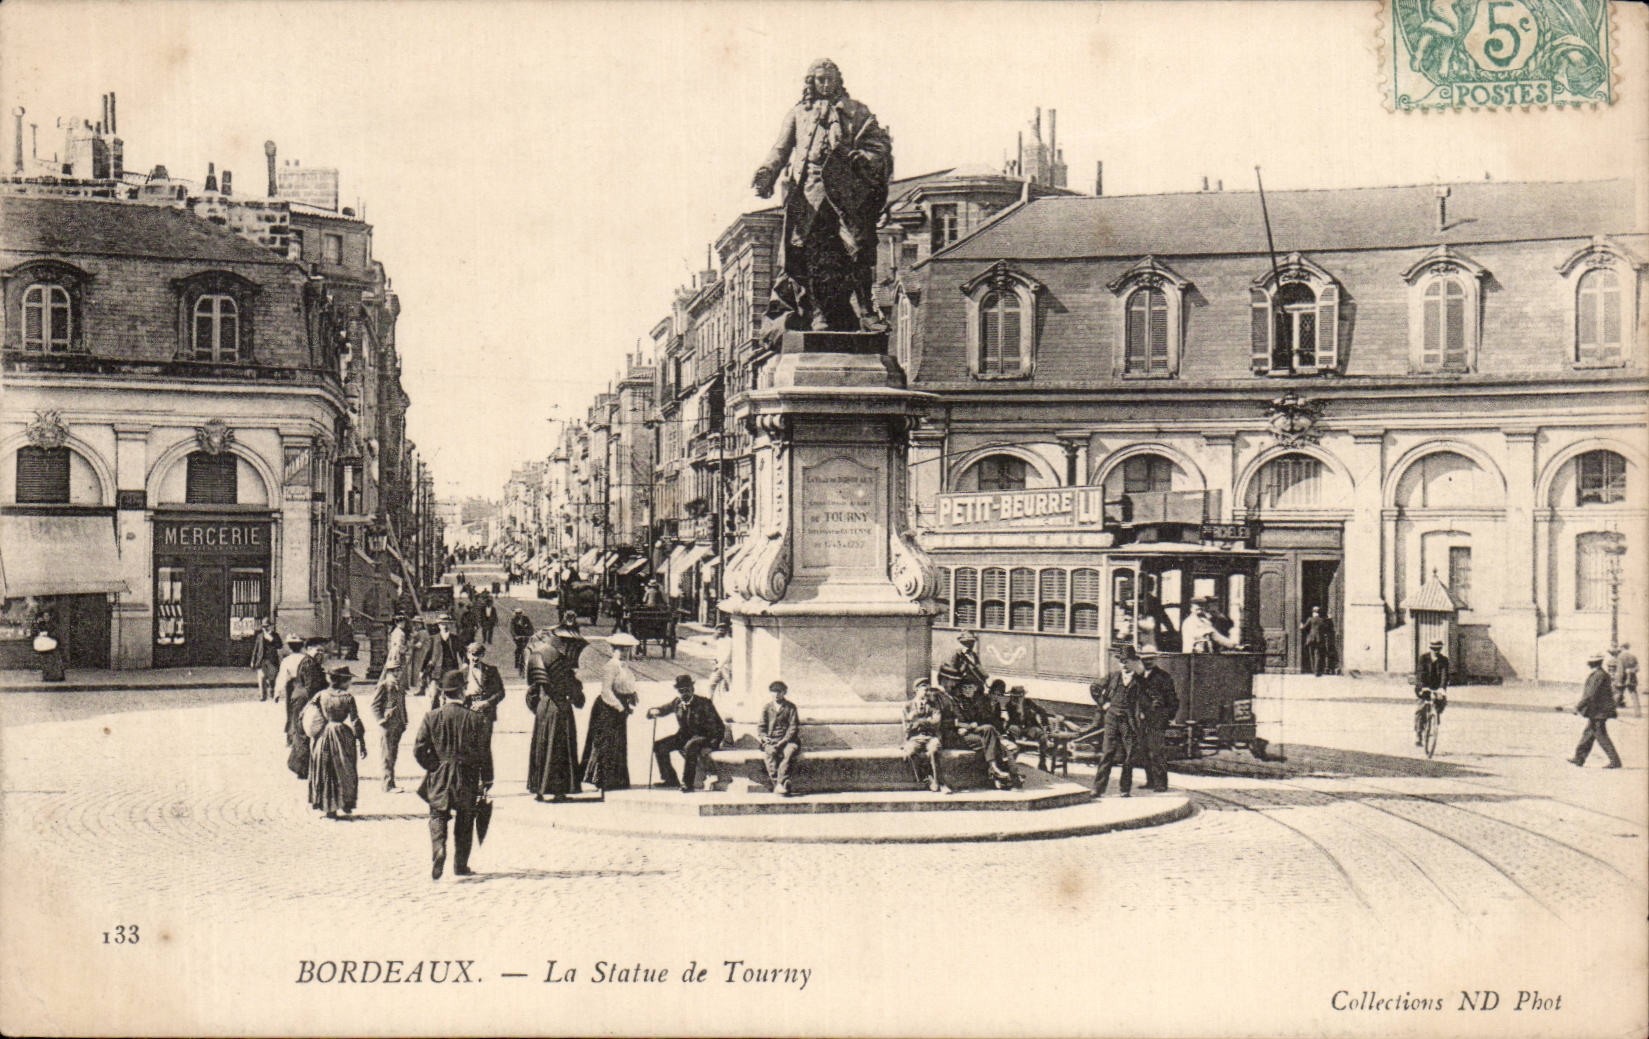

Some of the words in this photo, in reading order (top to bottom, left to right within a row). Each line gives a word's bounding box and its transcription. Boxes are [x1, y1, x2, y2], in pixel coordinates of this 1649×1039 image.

[1456, 83, 1549, 106] POSTES
[824, 511, 868, 522] TOURNY
[938, 491, 1073, 528] PETIT-BEURRE
[164, 526, 261, 546] MERCERIE
